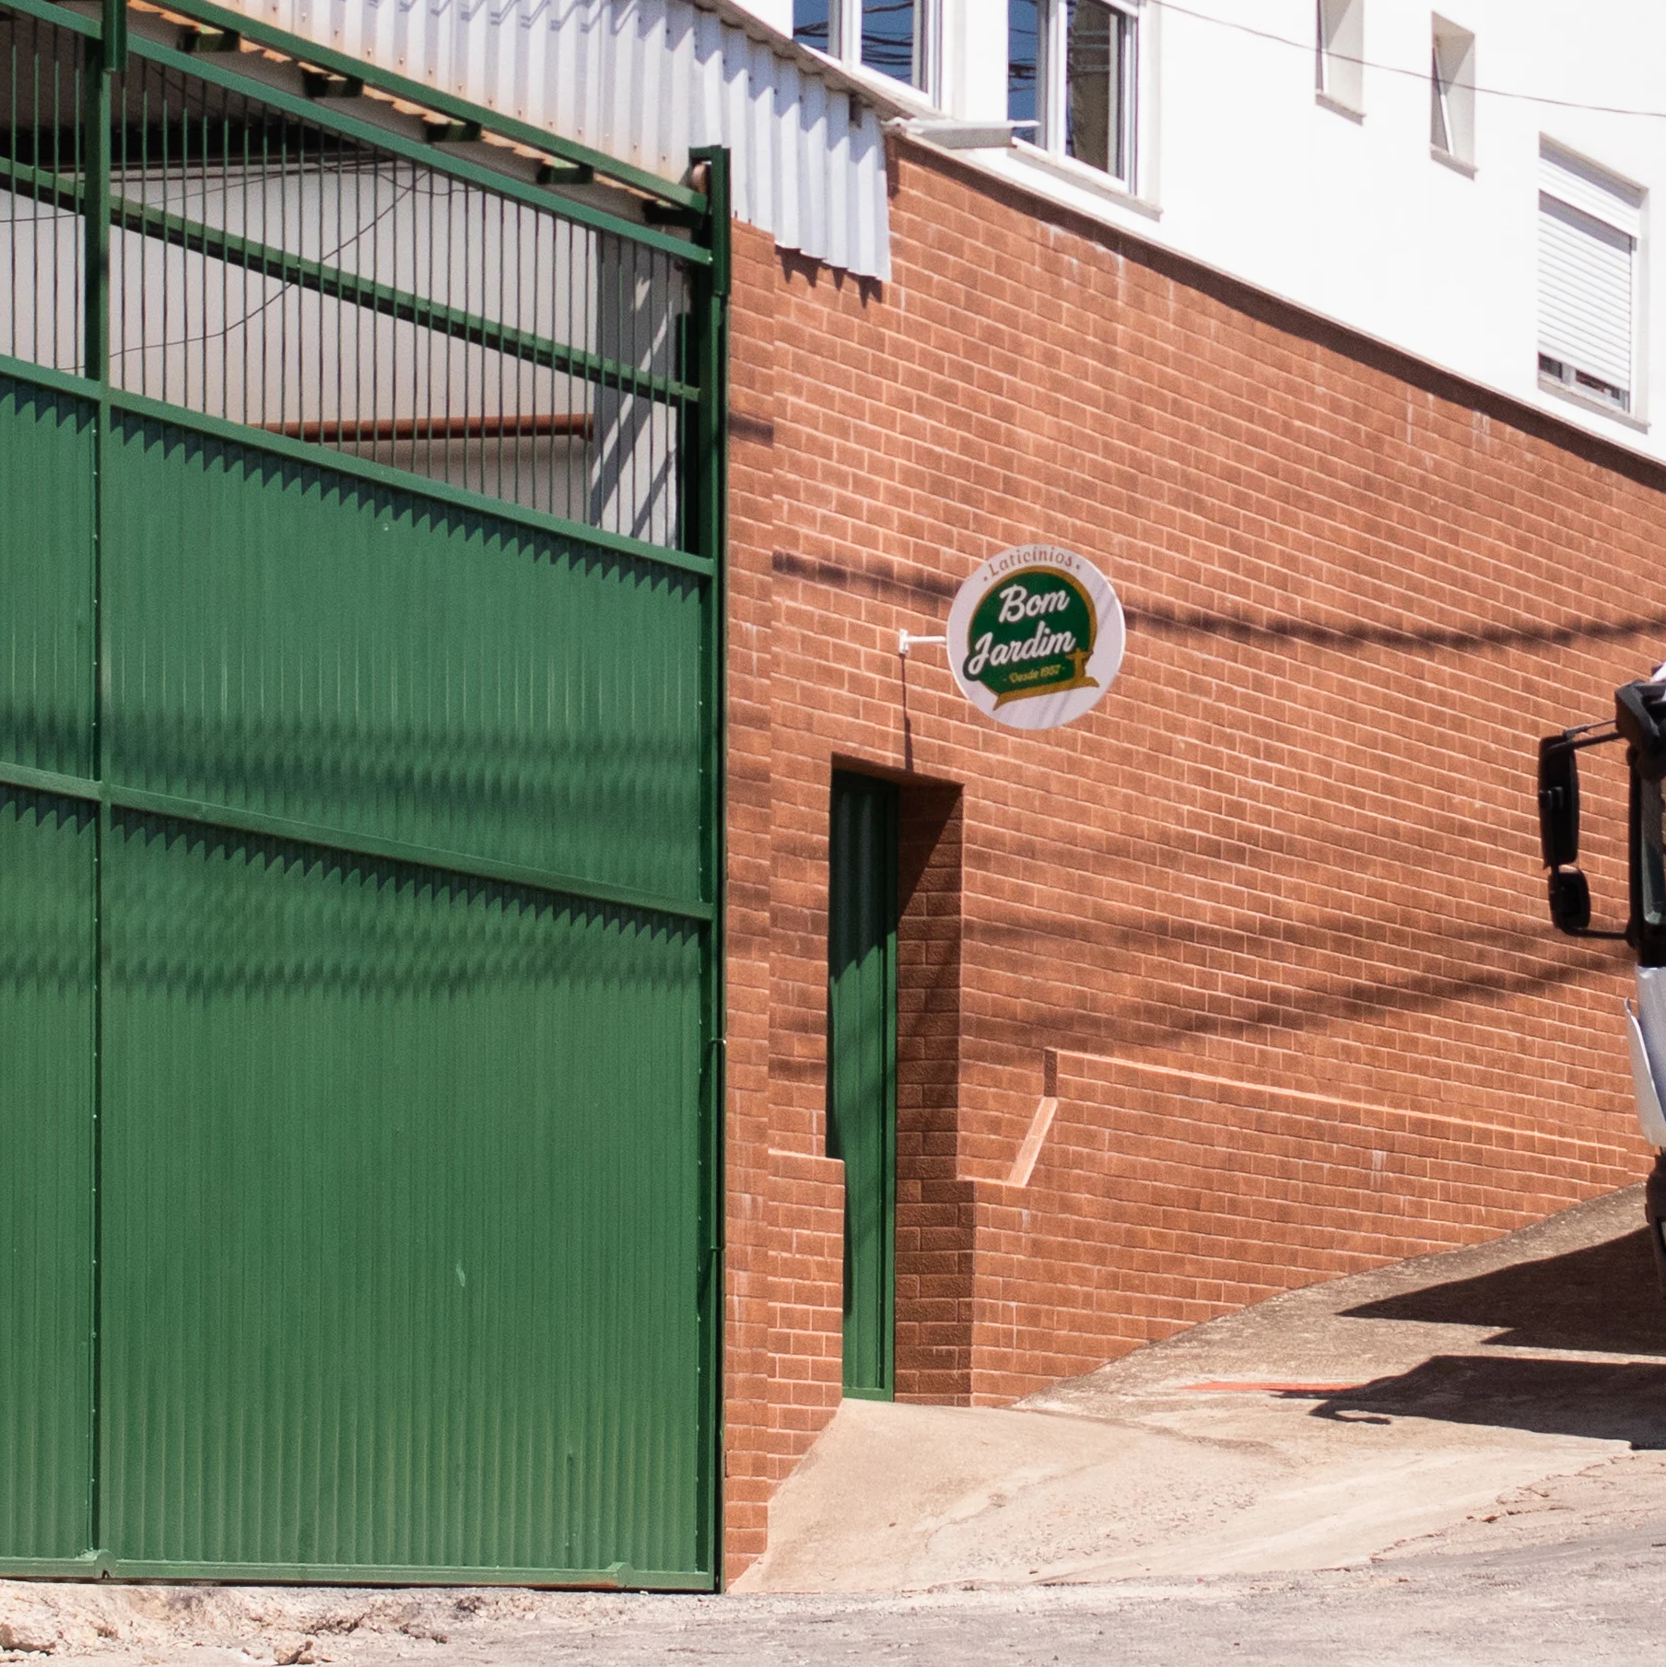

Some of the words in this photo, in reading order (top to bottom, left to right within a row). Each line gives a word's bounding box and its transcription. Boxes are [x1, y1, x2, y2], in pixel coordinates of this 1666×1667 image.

[988, 546, 1074, 577] Laticínios
[998, 583, 1071, 625] Bom
[967, 620, 1078, 676] Jardim
